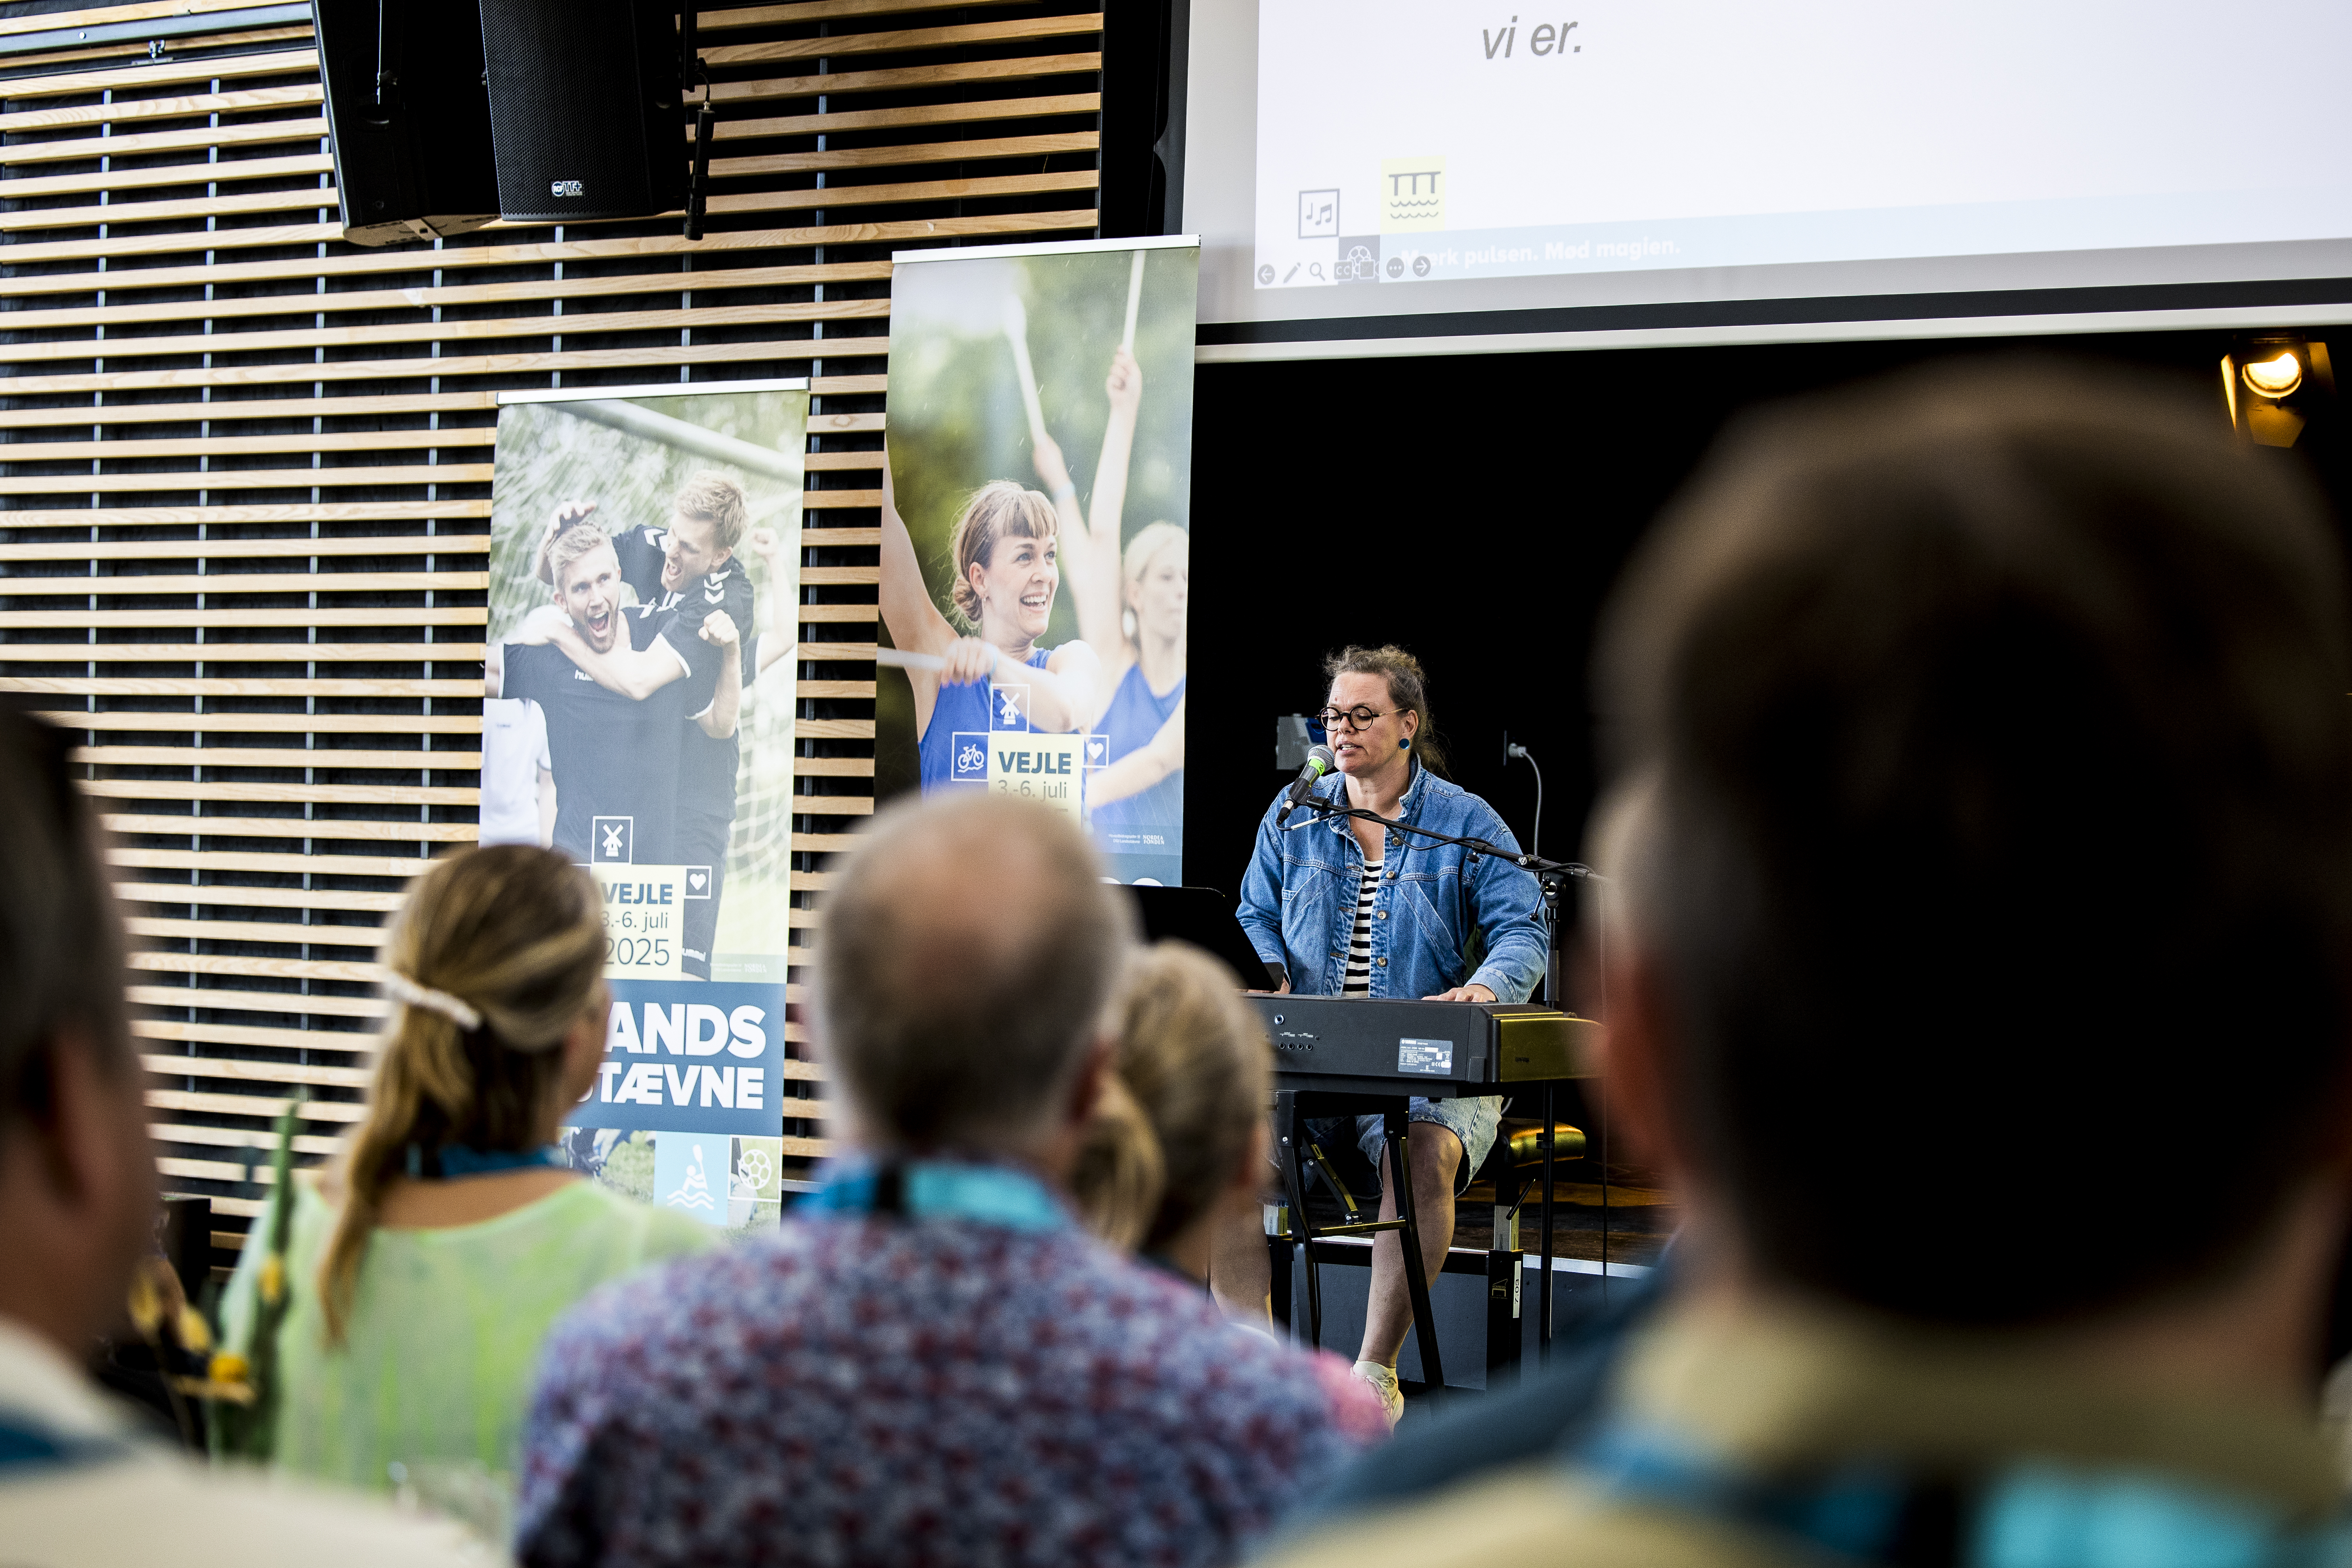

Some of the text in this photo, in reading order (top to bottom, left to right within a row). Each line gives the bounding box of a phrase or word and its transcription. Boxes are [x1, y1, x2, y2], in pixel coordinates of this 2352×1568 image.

[1483, 15, 1581, 59] vi er.
[1465, 245, 1538, 269] pulsen.
[1545, 240, 1590, 260] Mød
[1596, 236, 1680, 261] magien.
[998, 751, 1071, 774] VEJLE
[1040, 781, 1067, 802] juli
[600, 882, 673, 905] VEJLE
[642, 912, 668, 932] juli
[603, 1001, 766, 1059] ANDS
[577, 1062, 765, 1110] TÆVNE
